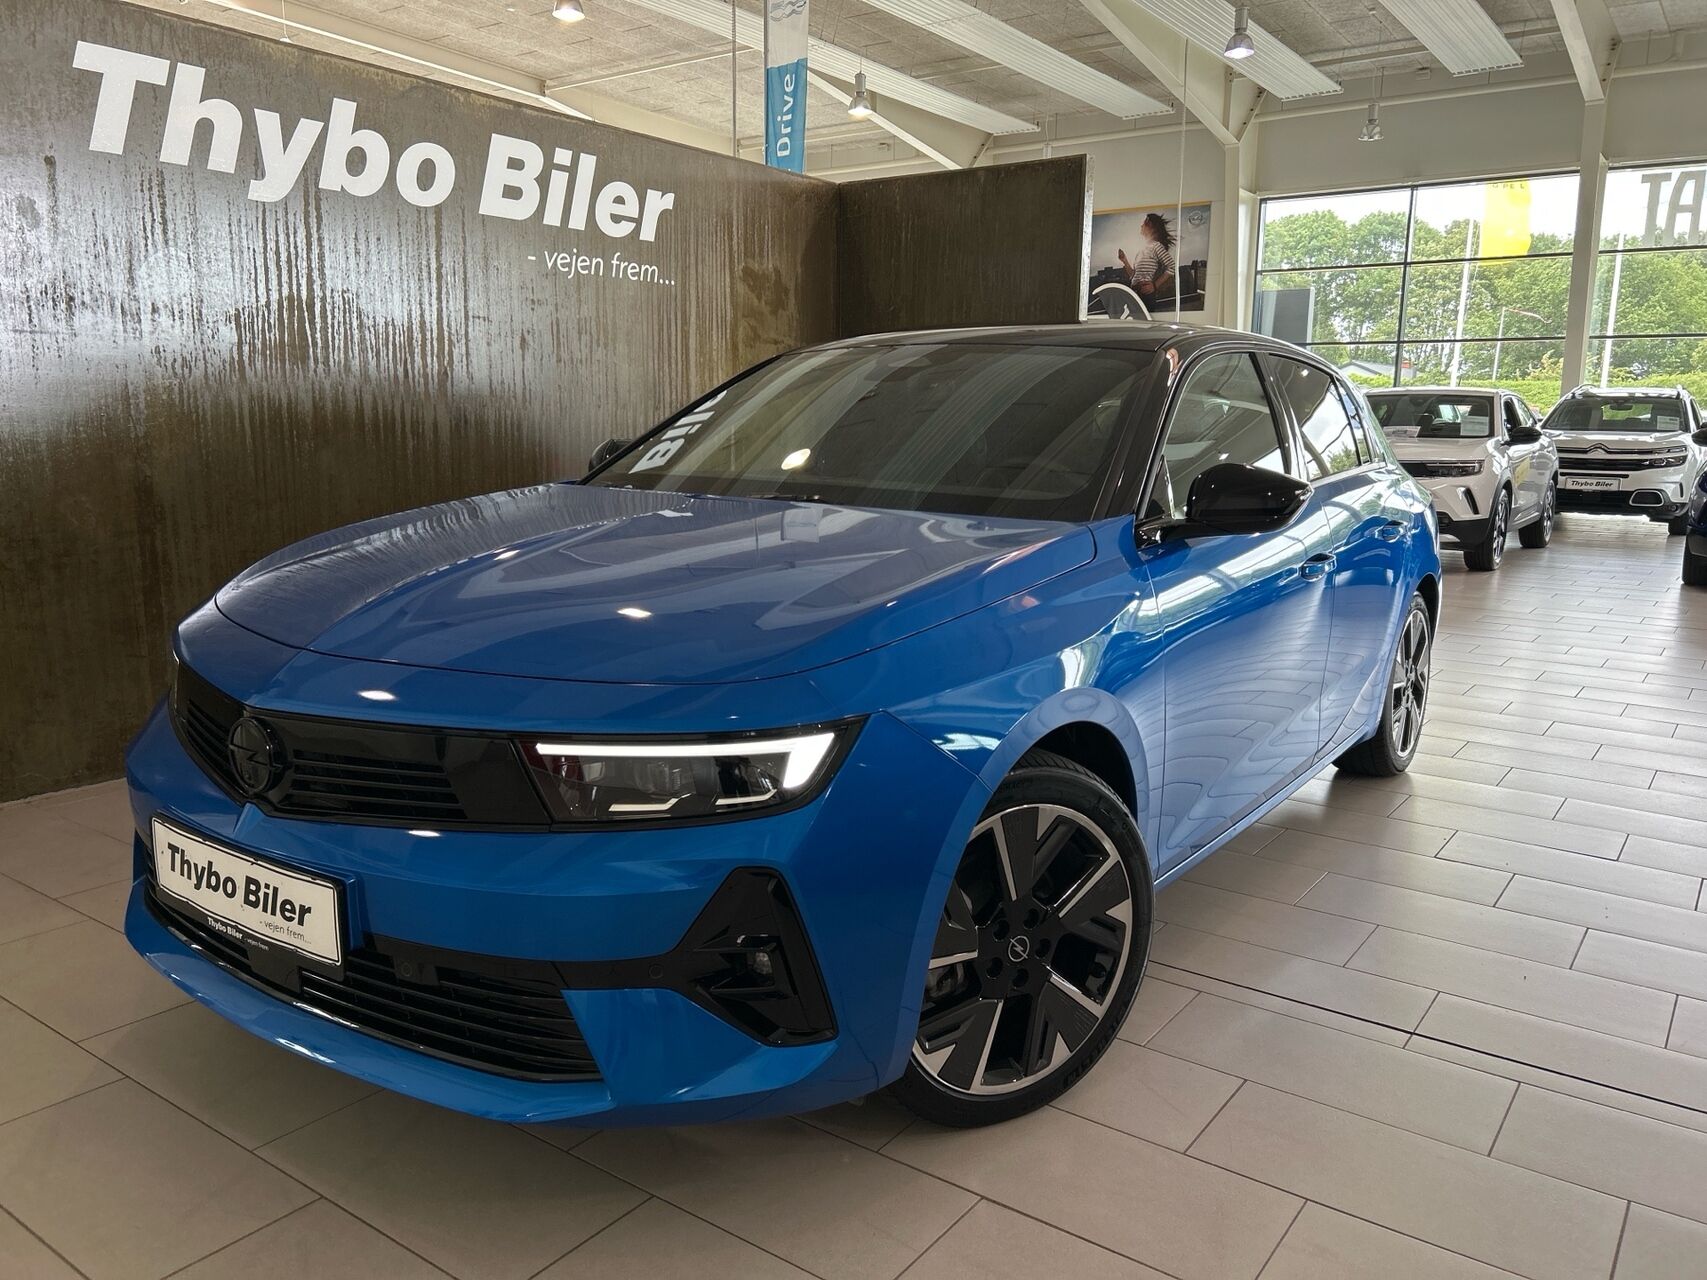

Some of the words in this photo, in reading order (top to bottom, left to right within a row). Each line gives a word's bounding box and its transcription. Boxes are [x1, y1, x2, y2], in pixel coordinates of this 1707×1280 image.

[776, 73, 796, 158] Drive
[72, 40, 456, 206] Thybo
[478, 133, 675, 242] Biler
[544, 248, 604, 279] vejen
[611, 252, 675, 285] frem...
[1571, 480, 1594, 488] Thybo
[167, 842, 237, 899] Thybo
[243, 875, 312, 927] Biler
[207, 916, 227, 933] Thybo
[227, 926, 243, 940] Biler
[264, 920, 285, 933] vejen
